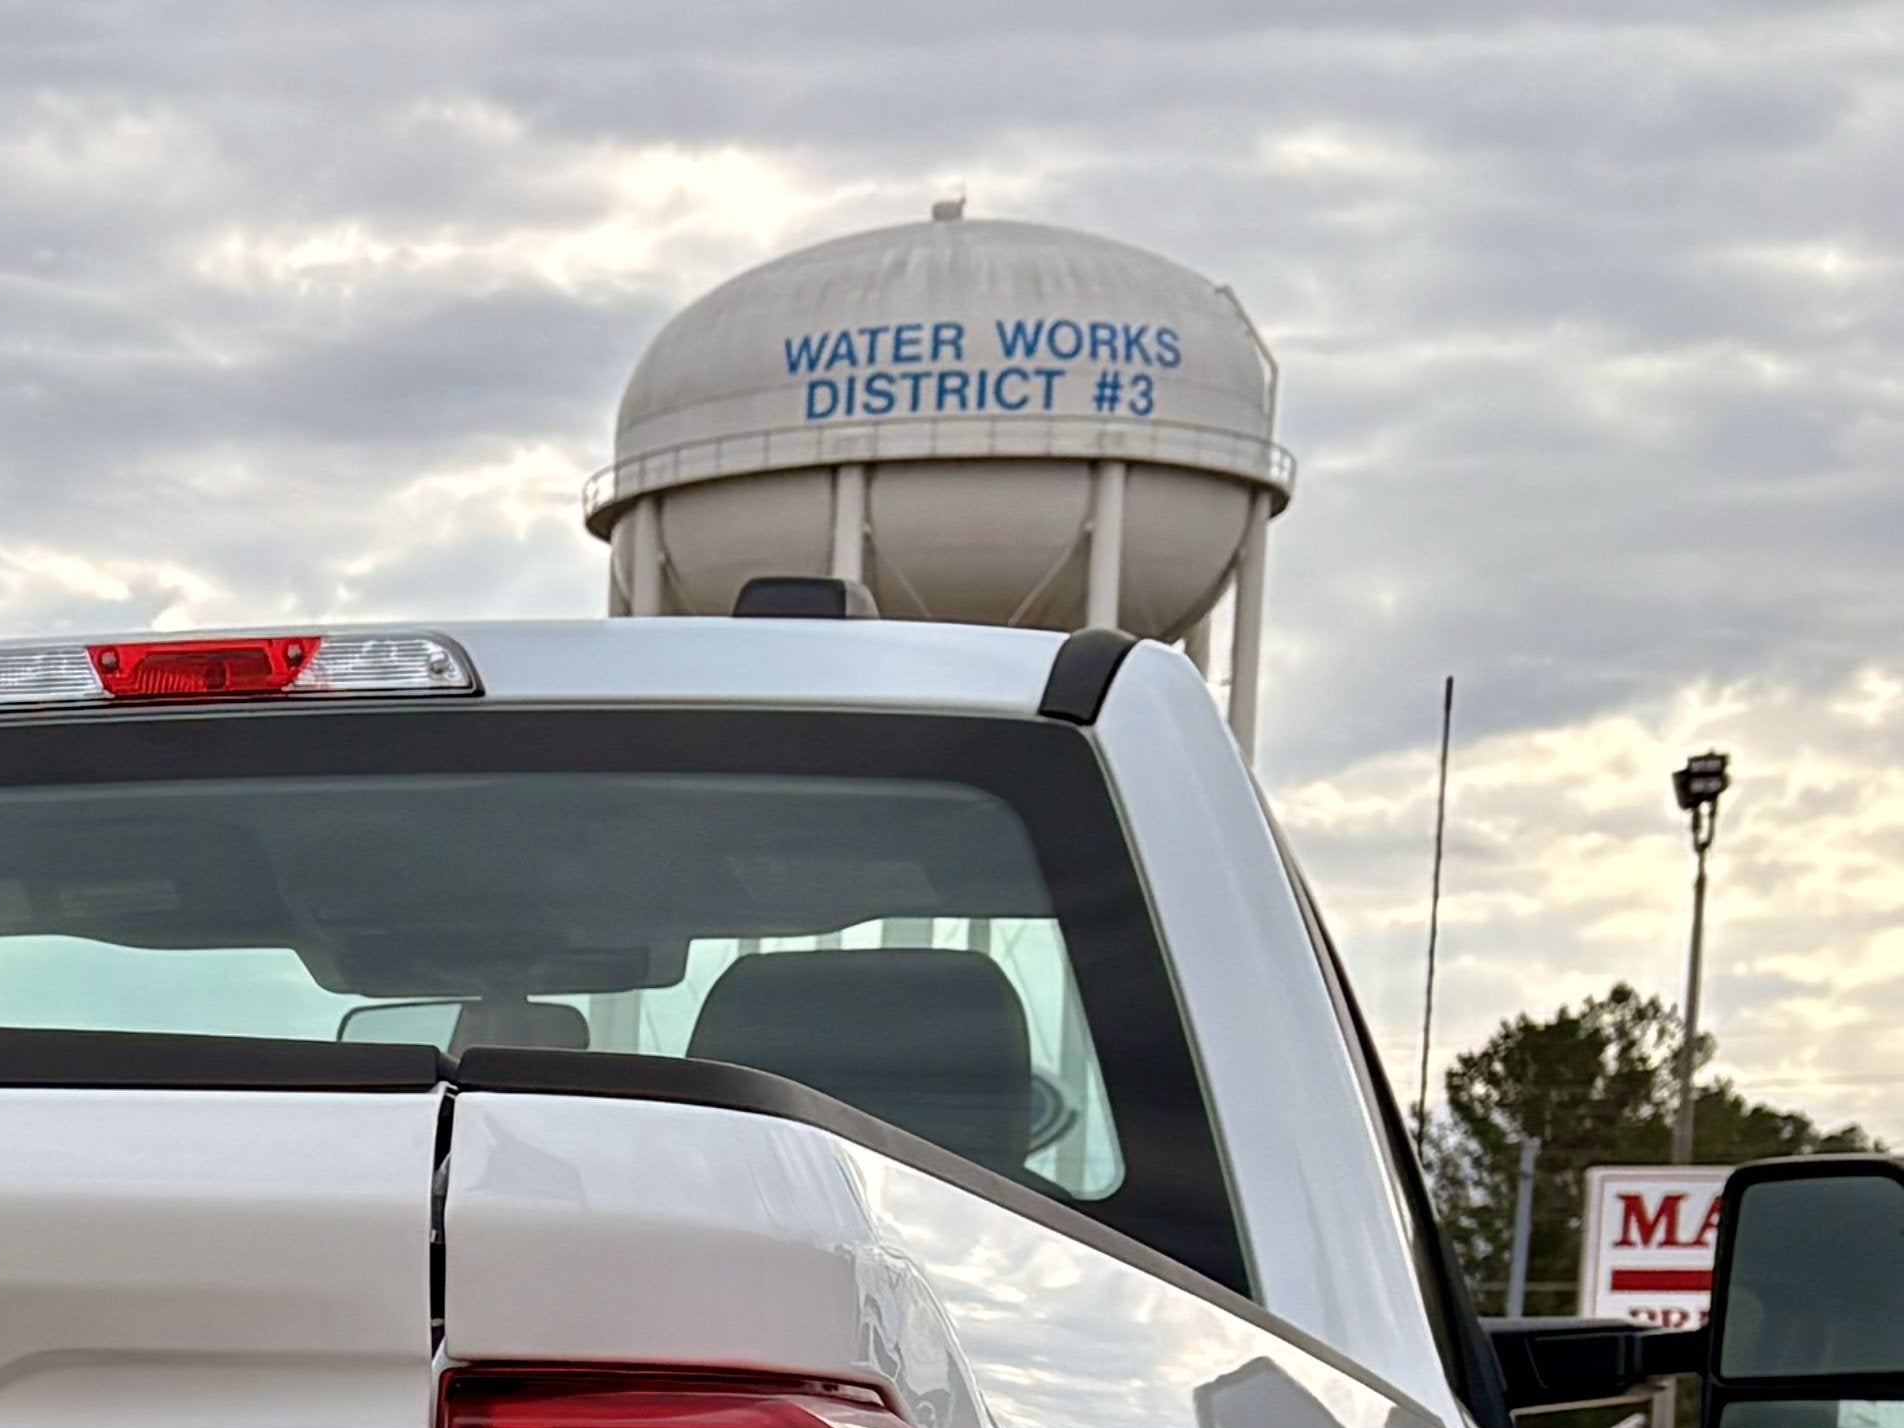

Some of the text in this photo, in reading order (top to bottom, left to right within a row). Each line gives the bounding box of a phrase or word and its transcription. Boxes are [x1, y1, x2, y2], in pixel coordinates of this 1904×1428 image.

[784, 319, 1182, 374] WATER WORKS
[805, 368, 1155, 419] DISTRICT #3
